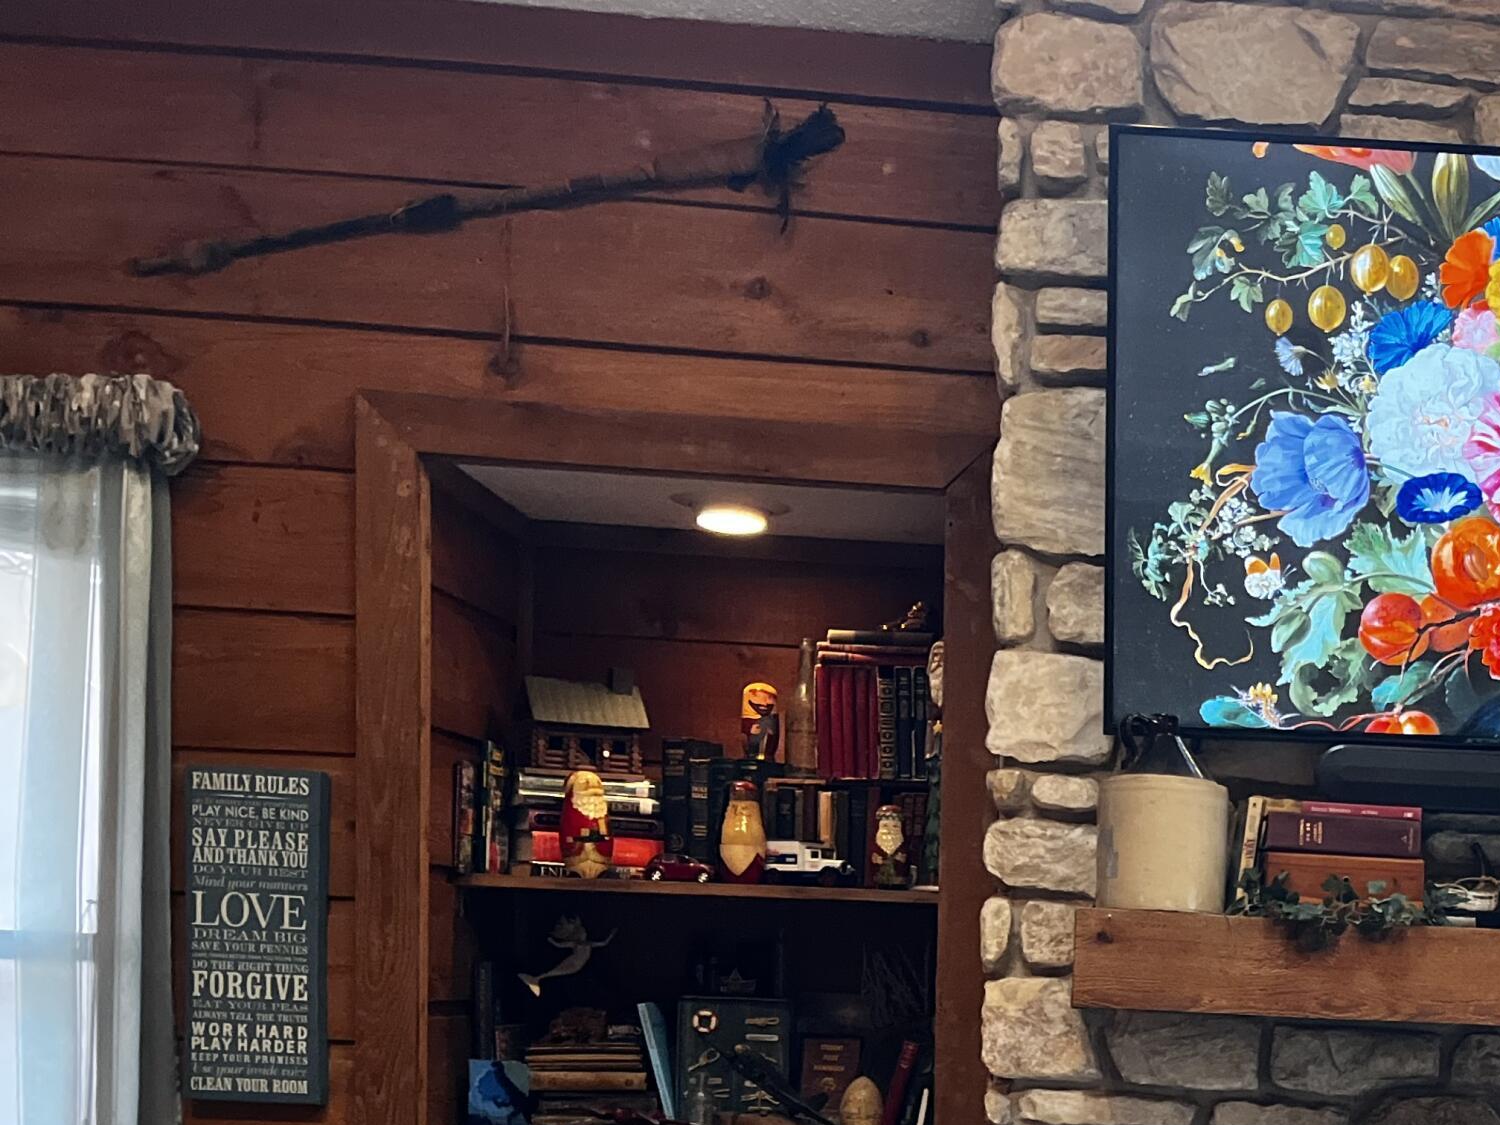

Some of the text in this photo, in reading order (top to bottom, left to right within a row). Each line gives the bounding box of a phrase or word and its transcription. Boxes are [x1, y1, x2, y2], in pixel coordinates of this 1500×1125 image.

[192, 772, 309, 795] FAMILY RULES
[192, 805, 309, 821] PLAY NICE, BE KIND
[193, 817, 244, 828] NEVER
[192, 827, 308, 852] SAY PLEASE
[193, 847, 308, 868] AND THANK YOU
[193, 865, 214, 874] DO
[228, 879, 255, 890] your
[192, 890, 306, 931] LOVE
[194, 928, 306, 944] DREAM BIG
[192, 940, 308, 955] SAVE YOUR PENNIES
[193, 959, 309, 973] DO THE RIGHT THING
[192, 970, 308, 1002] FORGIVE
[231, 1012, 253, 1021] TELL
[256, 1013, 275, 1022] THE
[277, 1013, 308, 1024] TRUTH
[192, 1021, 308, 1040] WORK HARD
[192, 1037, 307, 1054] PLAY HARDER
[192, 1053, 308, 1065] KEEP YOUR PROMISES
[191, 1076, 308, 1094] CLEAN YOUR ROOM
